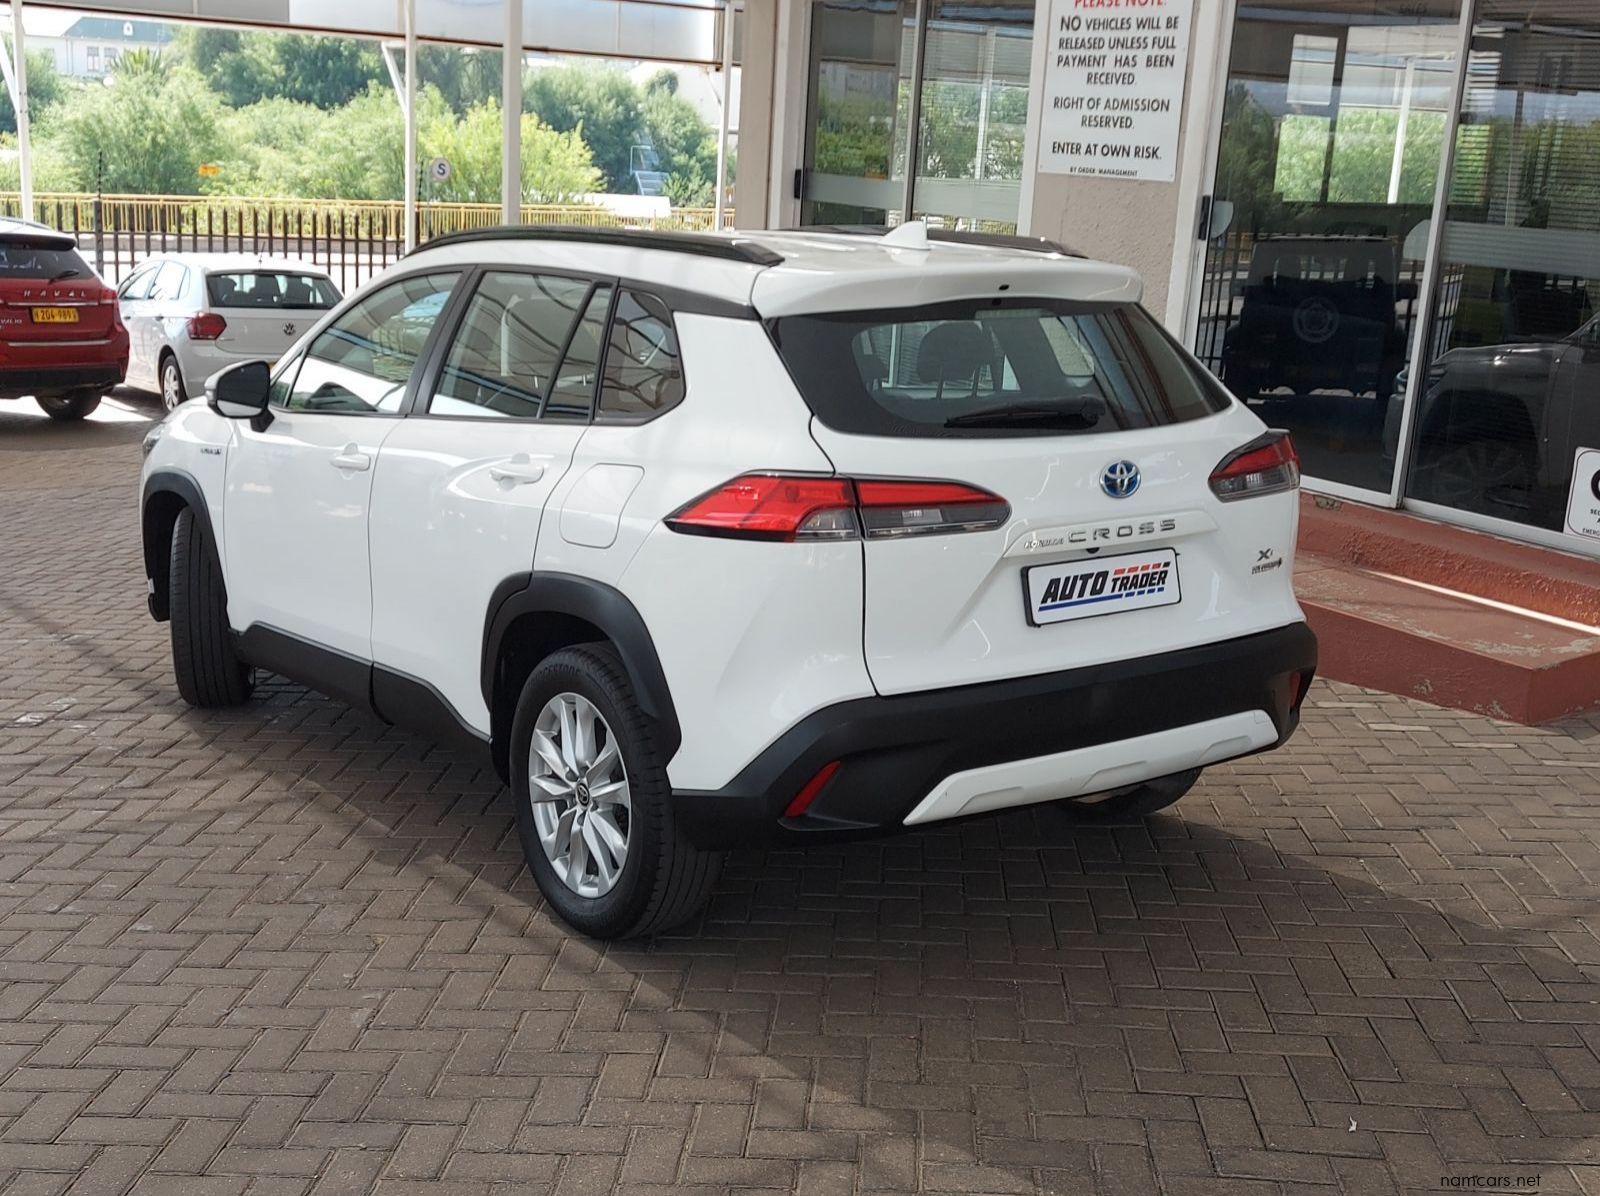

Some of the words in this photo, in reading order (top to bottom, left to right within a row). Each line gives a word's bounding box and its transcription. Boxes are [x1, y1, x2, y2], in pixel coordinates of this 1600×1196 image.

[1060, 15, 1081, 31] NO
[1086, 17, 1131, 31] VEHICLES
[1136, 16, 1161, 30] WILL
[1166, 16, 1179, 30] BE
[1058, 37, 1105, 50] RELEASED
[1108, 37, 1148, 50] UNLESS
[1151, 36, 1176, 49] FULL
[1057, 54, 1107, 68] PAYMENT
[1114, 55, 1137, 68] HAS
[1146, 54, 1175, 68] BEEN
[1053, 96, 1085, 109] RIGHT
[1087, 97, 1101, 110] OF
[1104, 98, 1170, 112] ADMISSION
[1051, 141, 1082, 155] ENTER
[1084, 143, 1099, 156] AT
[1101, 144, 1131, 158] OWN
[437, 163, 446, 176] S
[1068, 518, 1176, 544] CROSS
[1040, 569, 1109, 605] AUTO
[1110, 569, 1169, 594] TRADER
